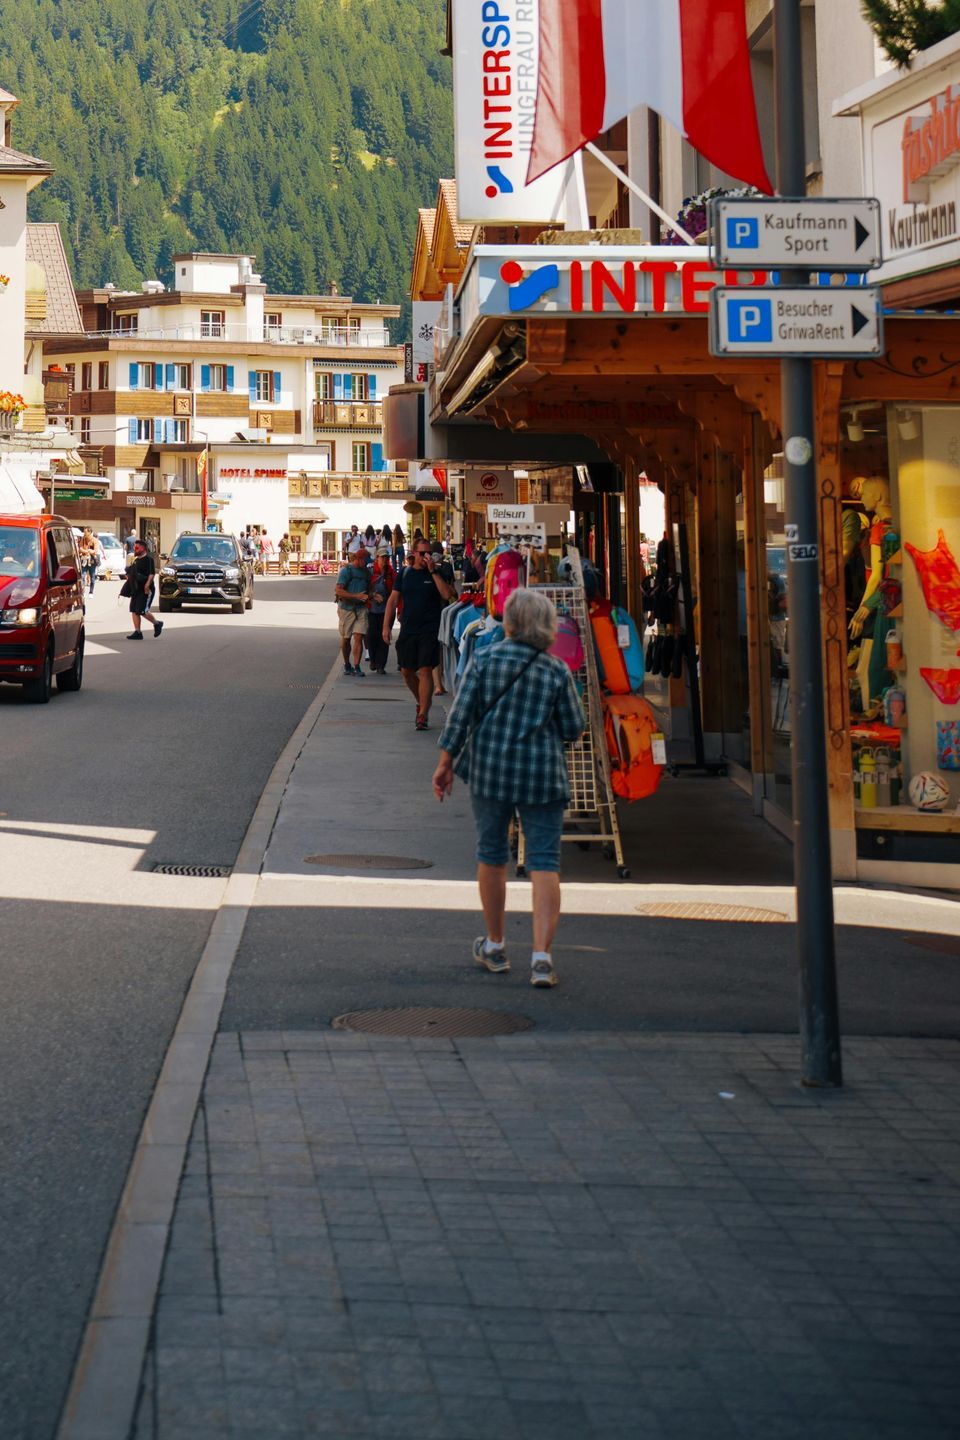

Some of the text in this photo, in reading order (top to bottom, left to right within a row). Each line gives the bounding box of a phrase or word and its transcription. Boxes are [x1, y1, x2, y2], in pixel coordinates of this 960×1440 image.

[516, 31, 538, 153] JUNGFRAU
[764, 213, 848, 230] Kaufmann
[888, 200, 957, 250] Kaufmann
[784, 235, 829, 255] Sport
[776, 300, 833, 317] Besucher
[778, 323, 845, 340] GriwaRent
[220, 468, 287, 479] HOTEL SPINNE
[126, 495, 156, 506] ESPRESSO-BAR
[492, 508, 526, 519] Belsun
